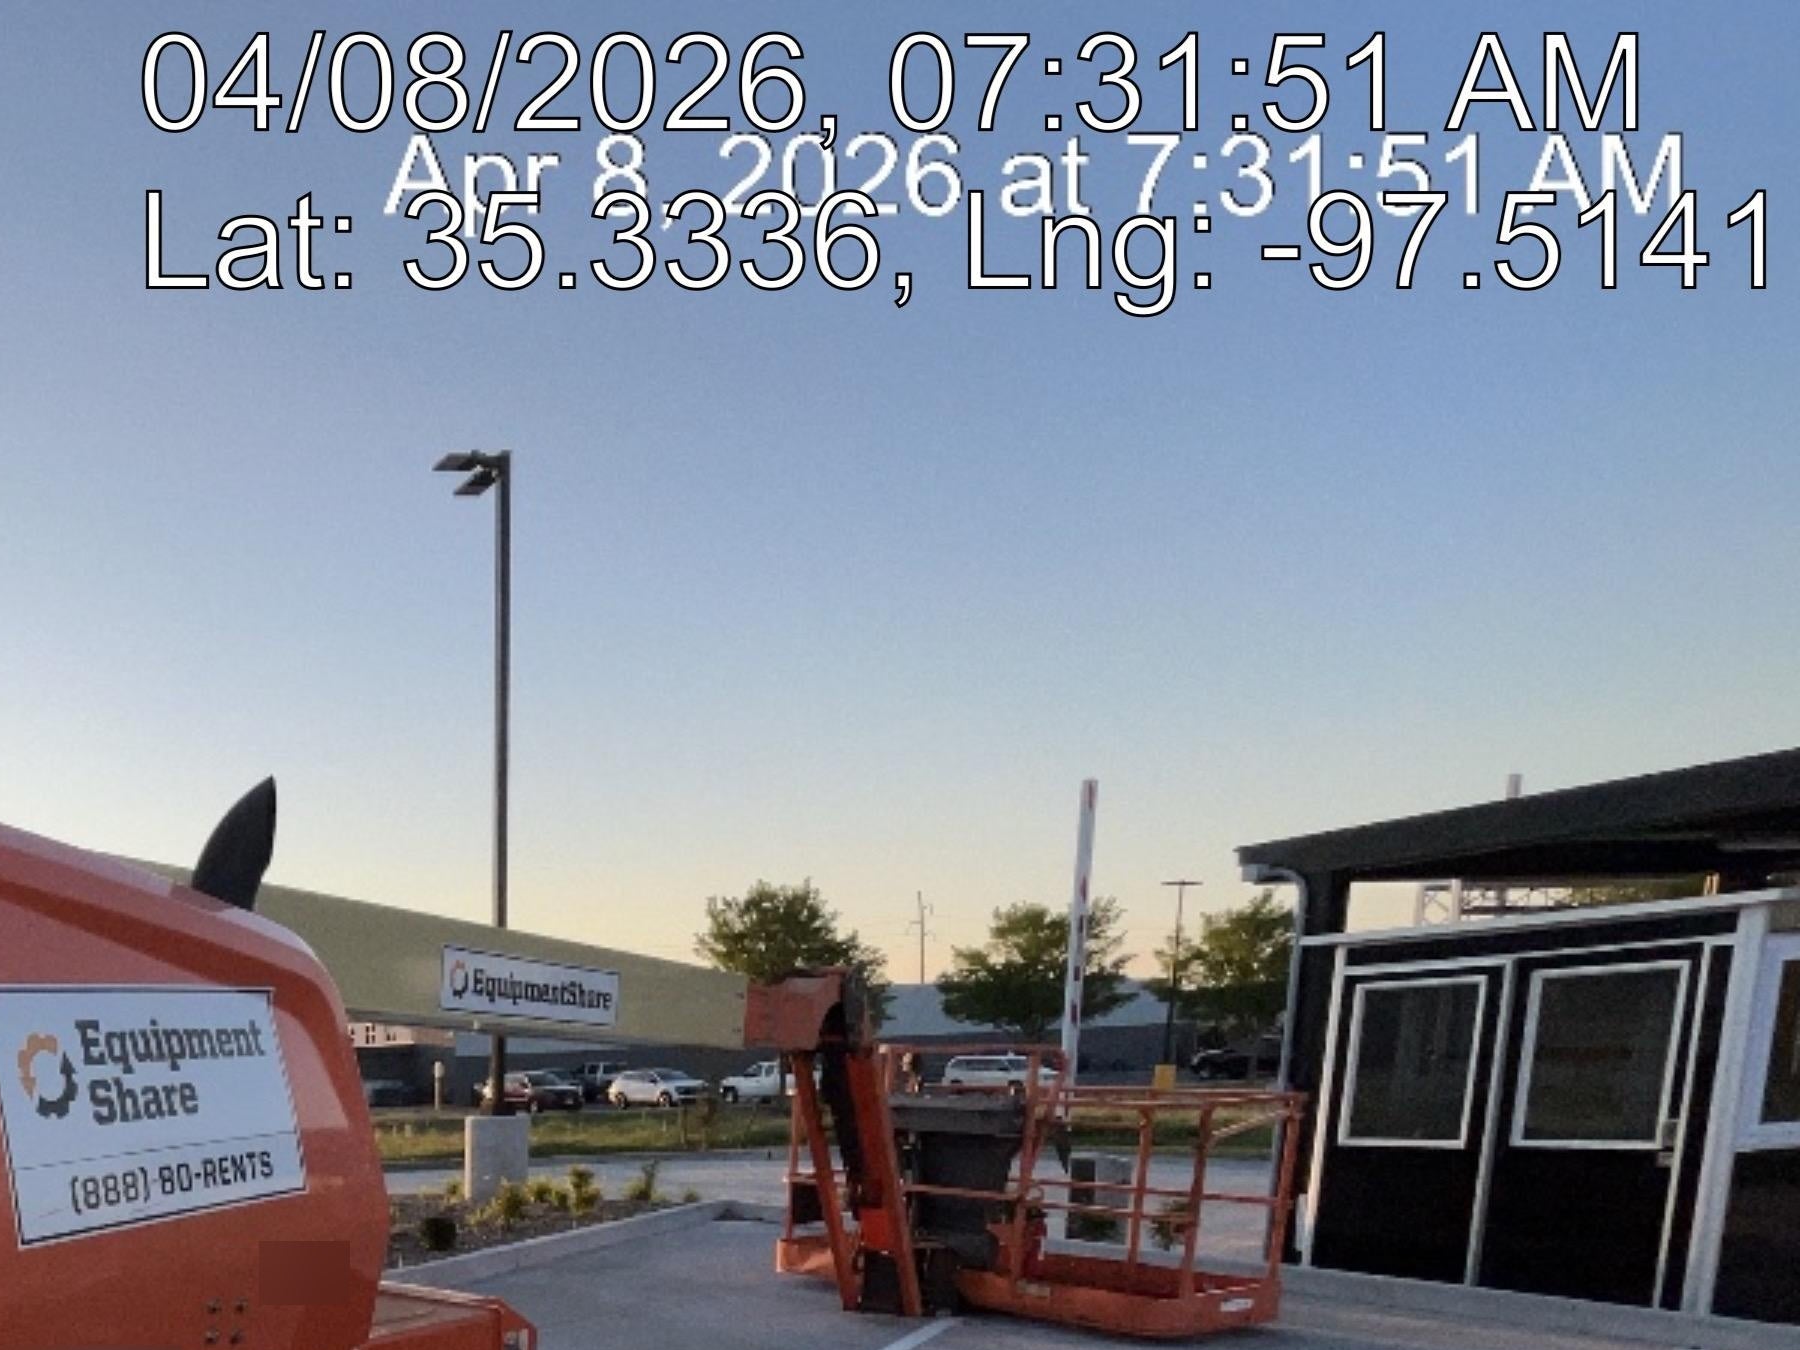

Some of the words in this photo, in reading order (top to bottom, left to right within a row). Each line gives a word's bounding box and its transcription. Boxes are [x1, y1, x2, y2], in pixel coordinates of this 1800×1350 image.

[472, 967, 613, 1010] EquipmentShare
[74, 1017, 266, 1075] Equipment
[88, 1076, 199, 1125] Share
[70, 1166, 151, 1215] (888)
